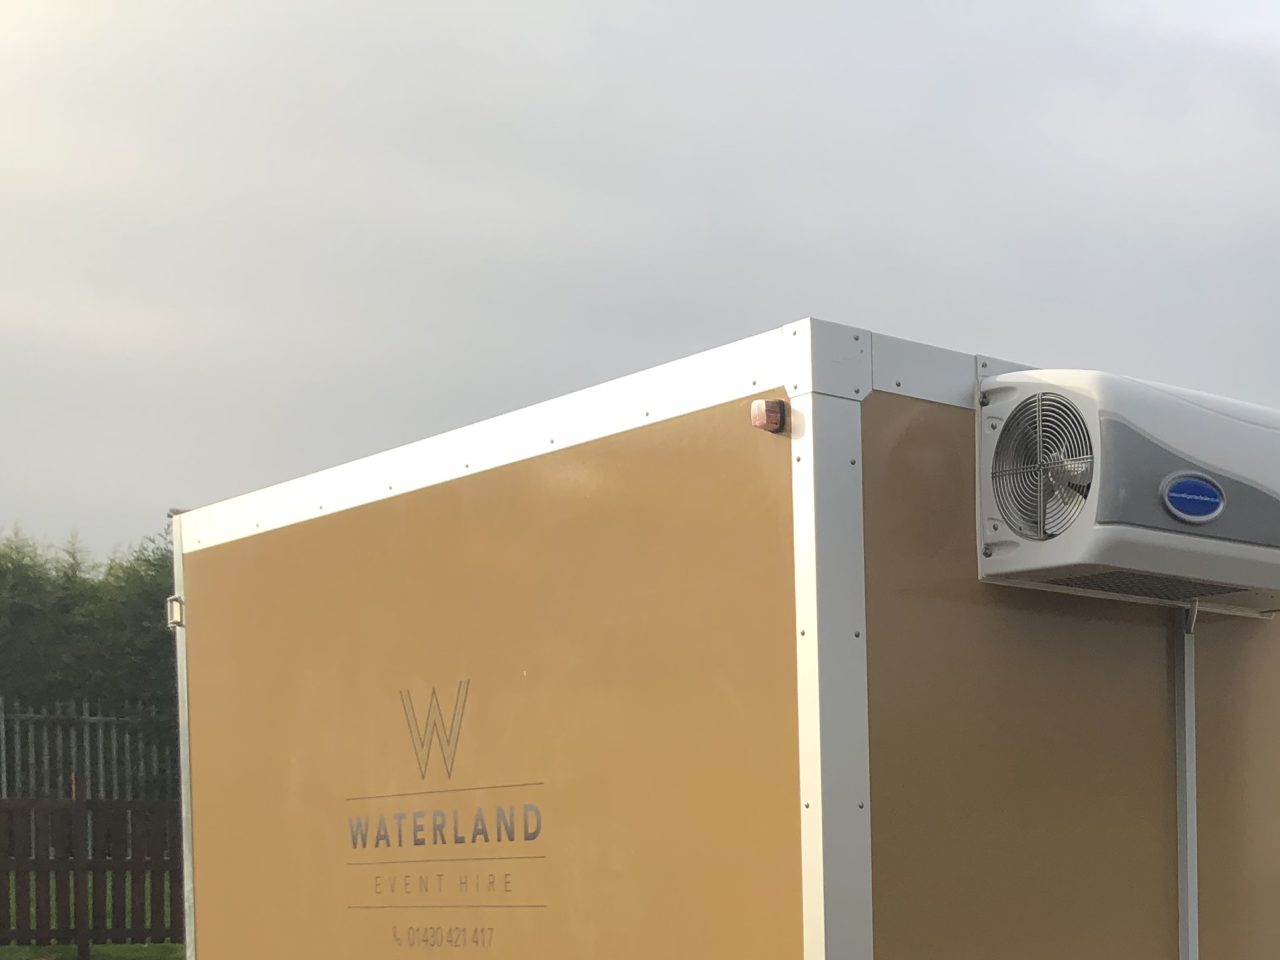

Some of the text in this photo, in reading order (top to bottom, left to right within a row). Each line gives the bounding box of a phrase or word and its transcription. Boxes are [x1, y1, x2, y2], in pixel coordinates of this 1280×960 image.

[349, 803, 543, 850] WATERLAND
[375, 872, 512, 894] EVENT HIRE
[407, 926, 494, 949] 01430 421 417
